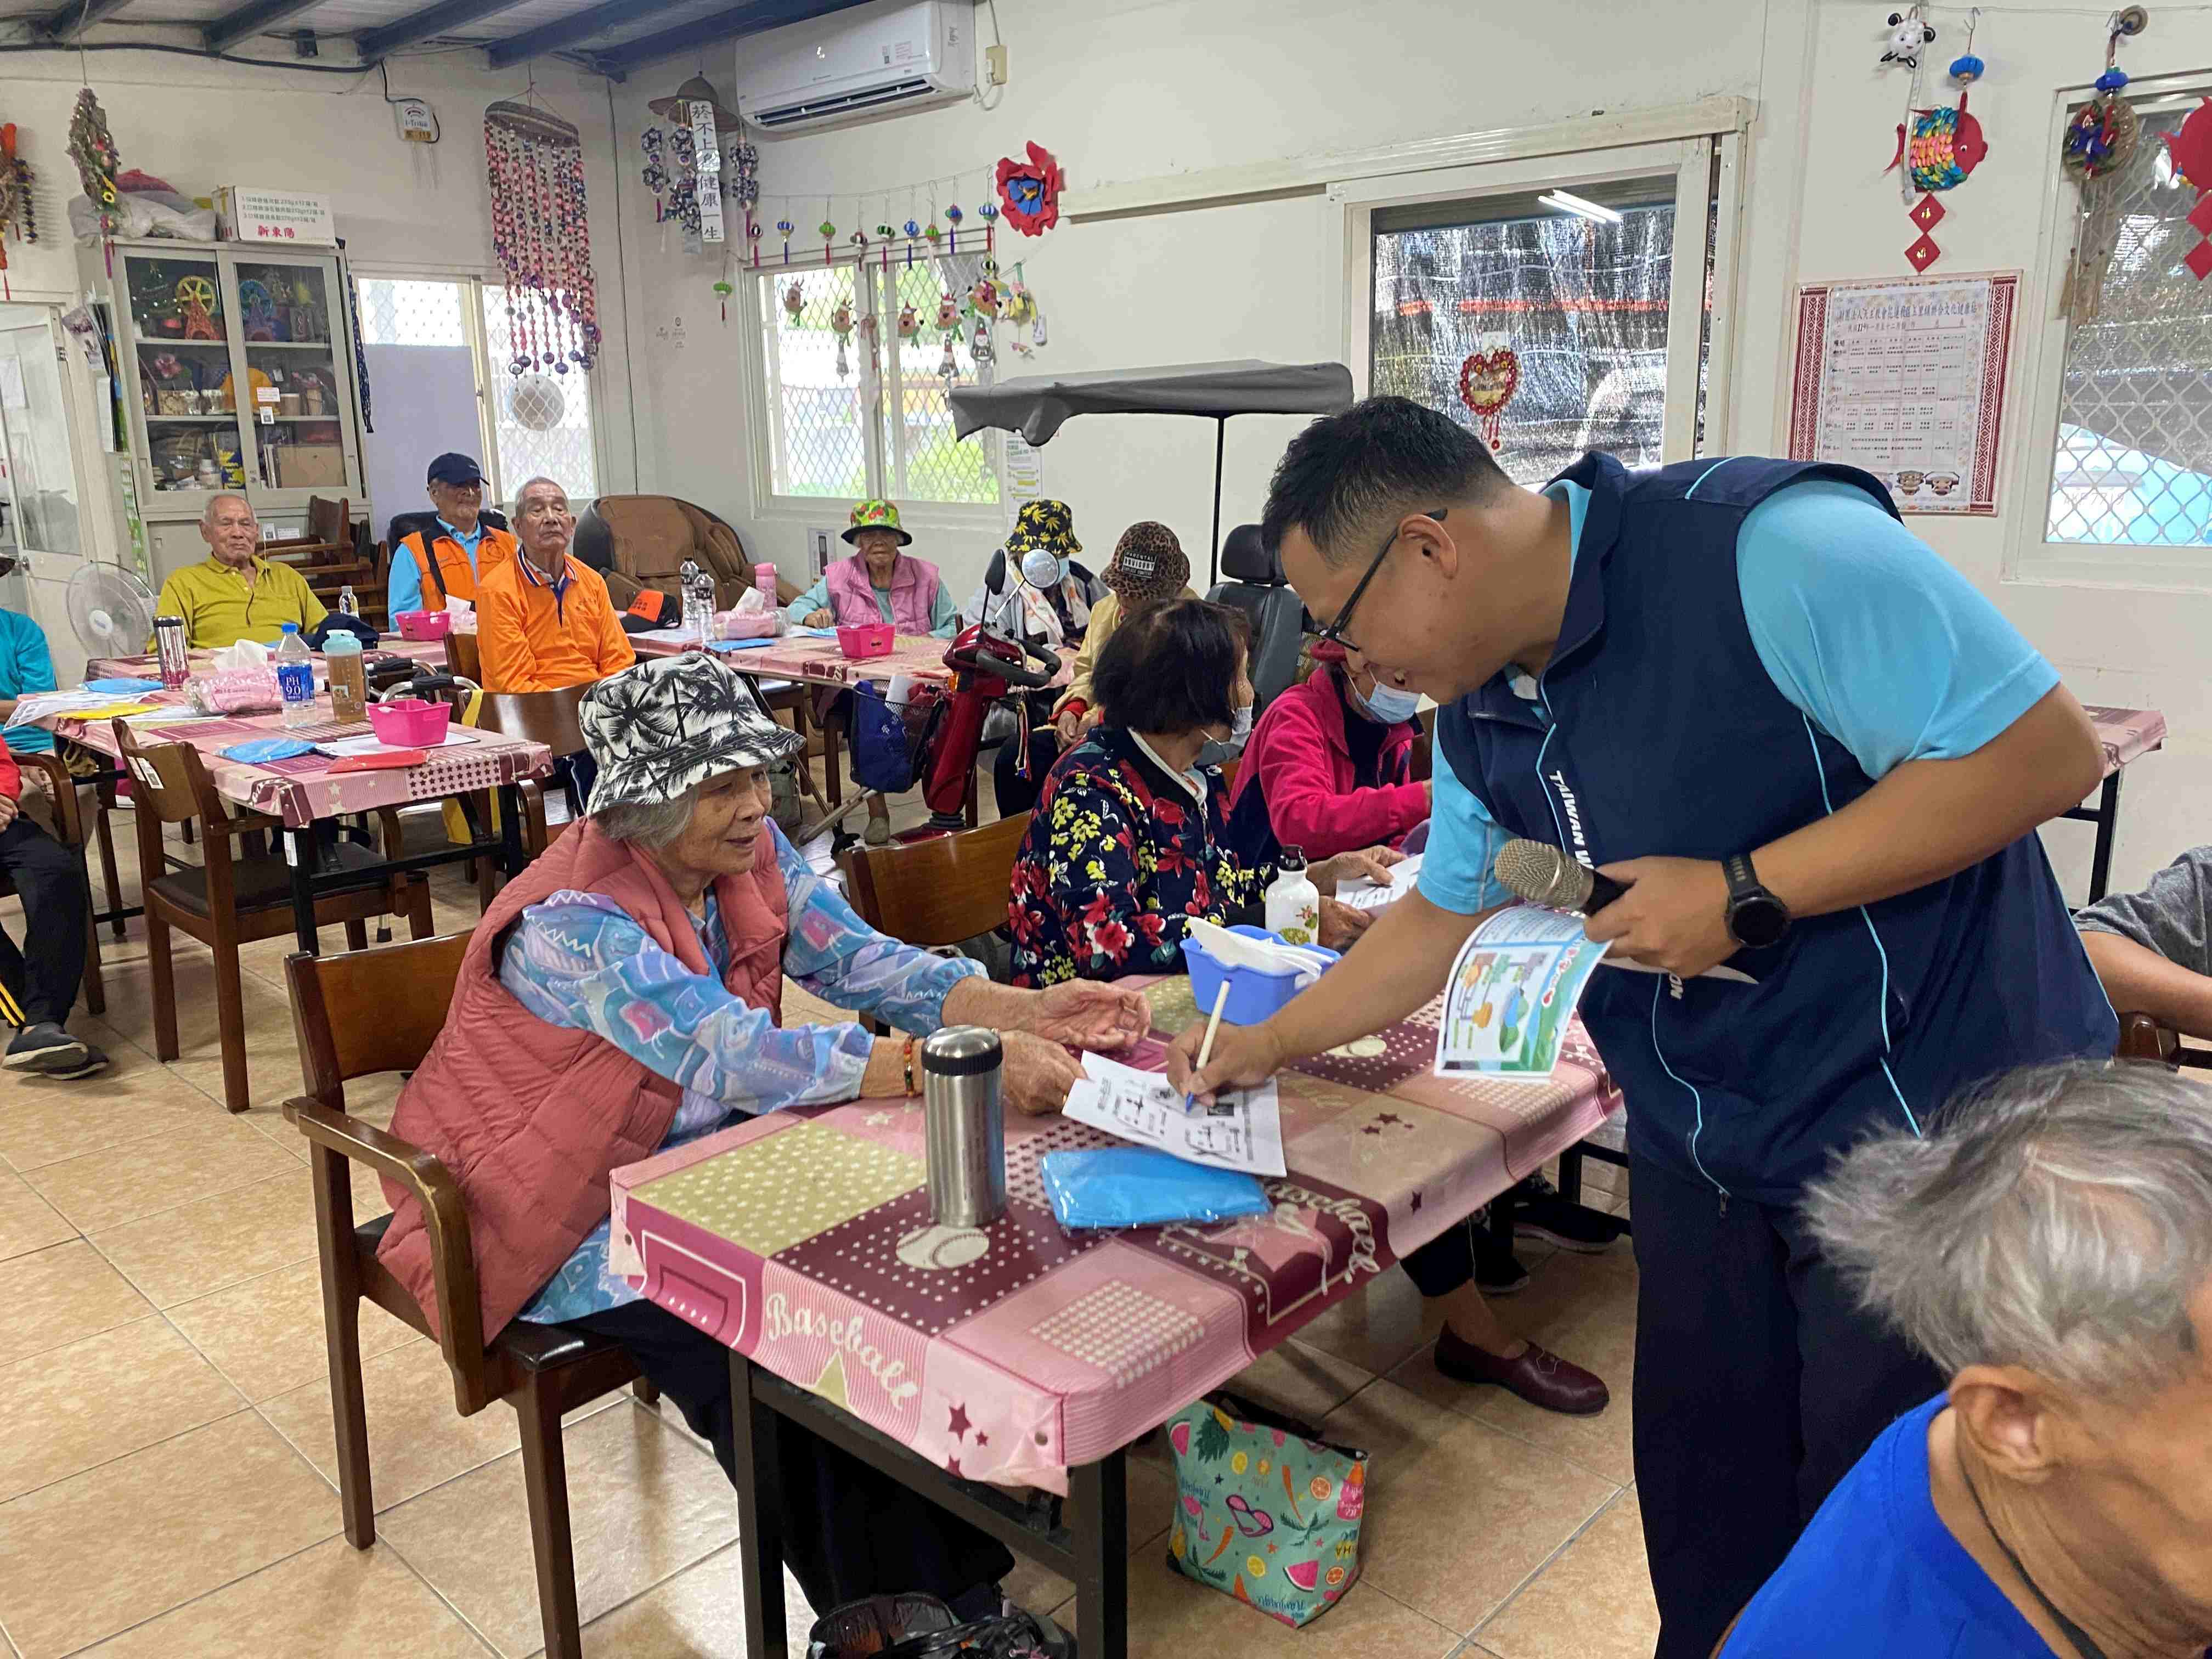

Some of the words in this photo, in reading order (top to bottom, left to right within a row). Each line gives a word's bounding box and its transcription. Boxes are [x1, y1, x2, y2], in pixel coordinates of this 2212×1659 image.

[698, 176, 721, 240] 健康一生
[257, 225, 295, 238] 新東陽
[1126, 551, 1154, 561] PARENTAL
[1124, 557, 1154, 571] ADVISORY
[286, 676, 299, 686] PH
[286, 685, 301, 695] 9.0
[1549, 770, 1585, 845] TAIWAN
